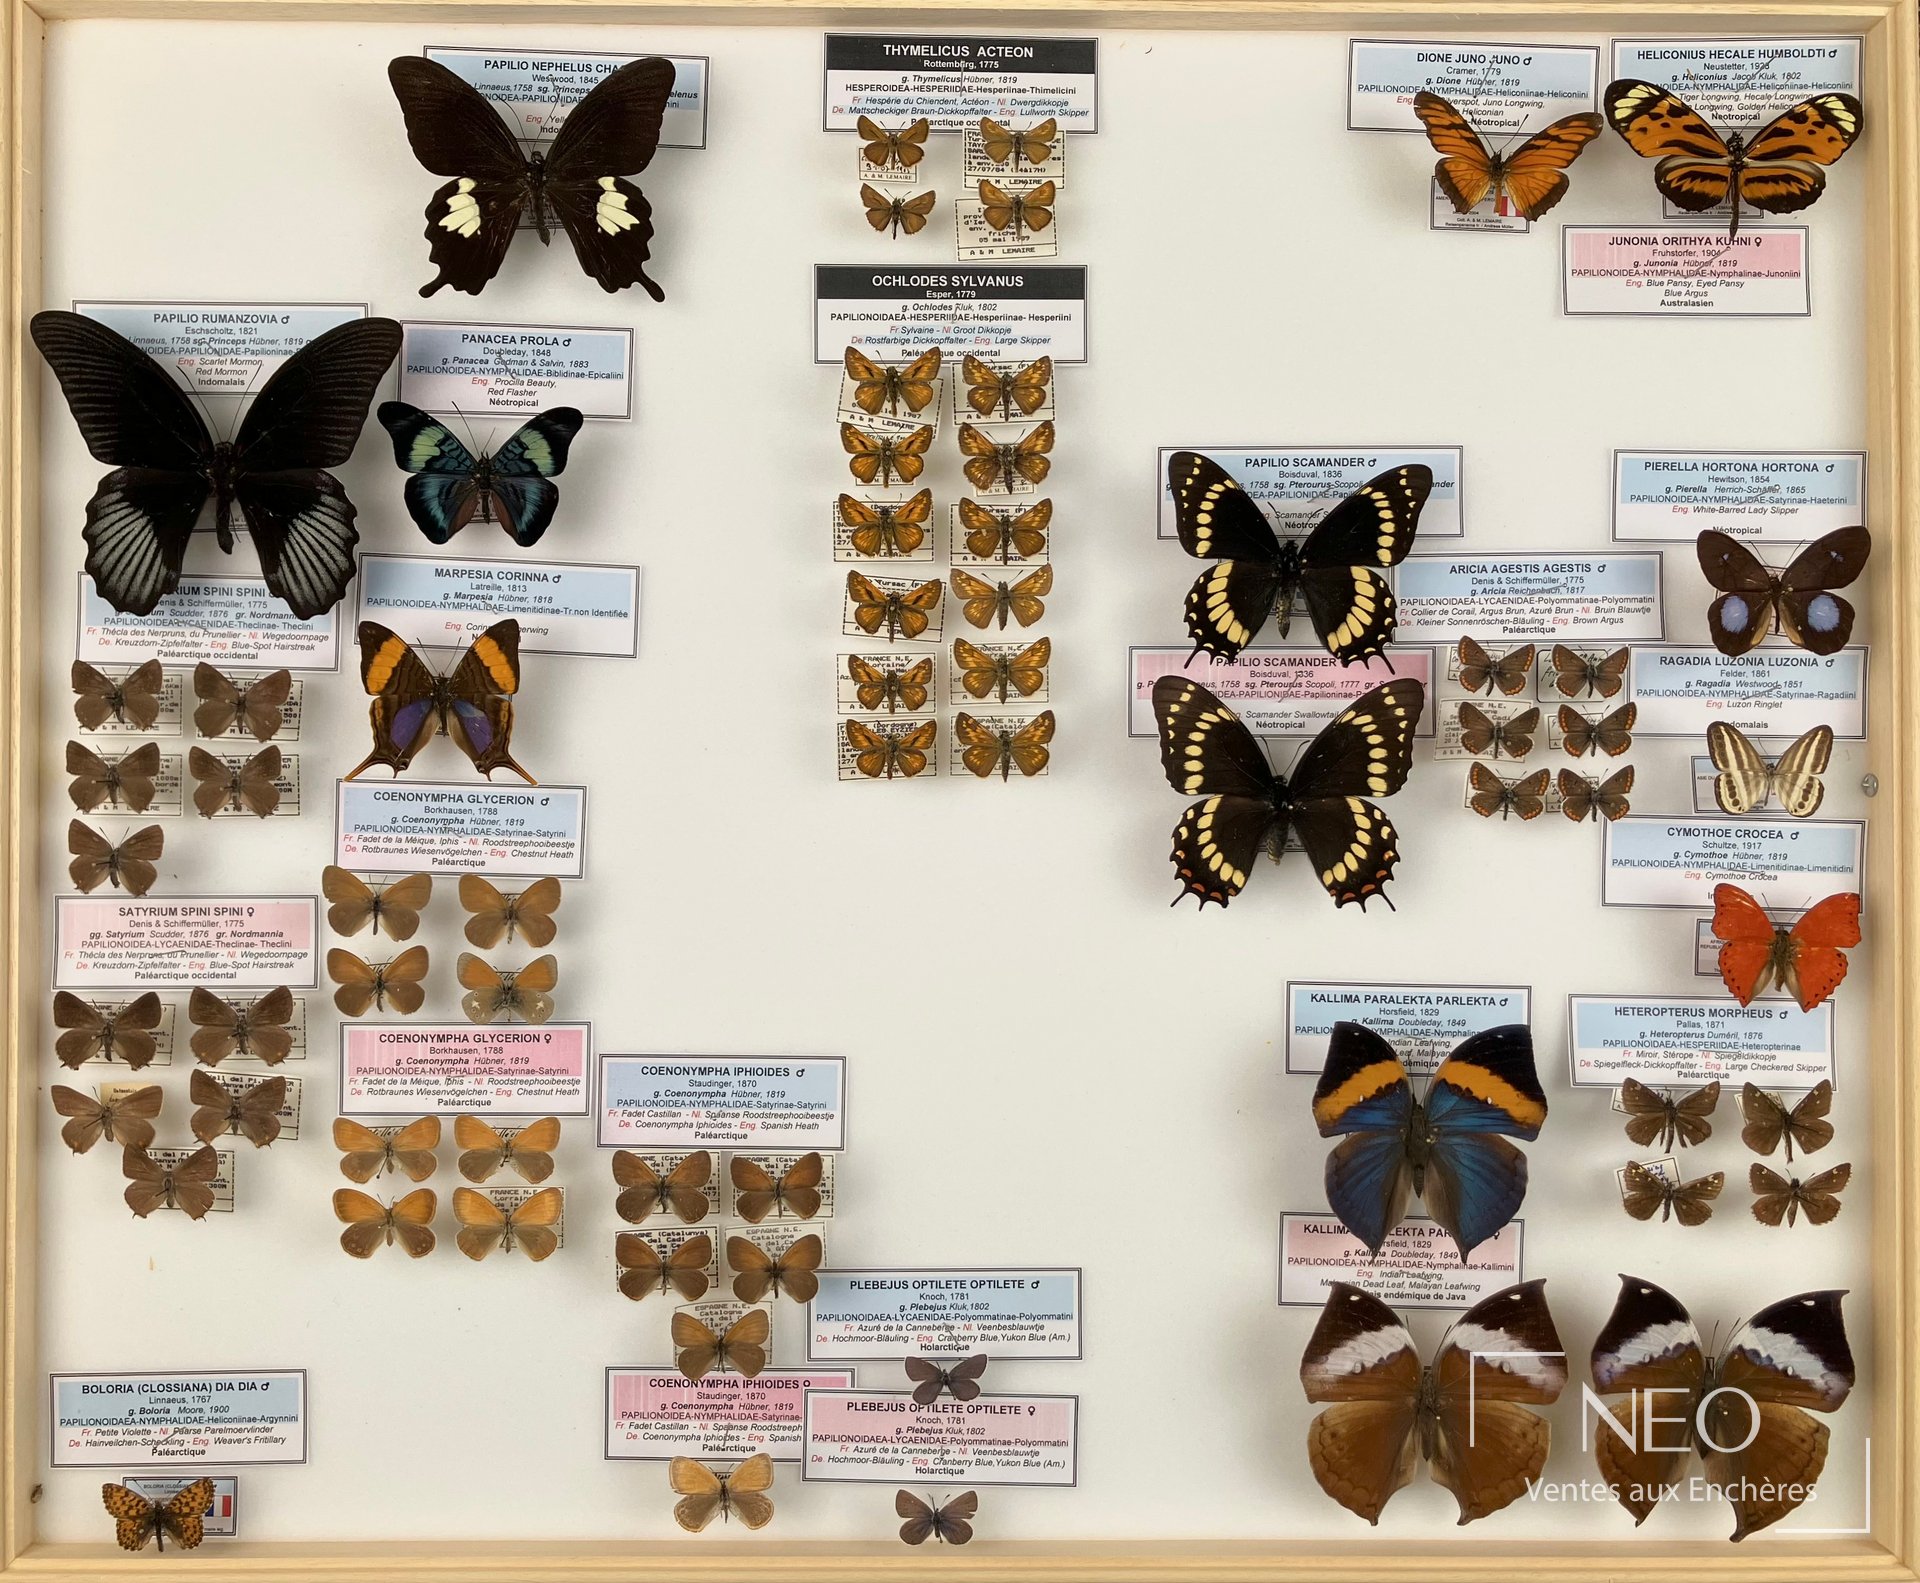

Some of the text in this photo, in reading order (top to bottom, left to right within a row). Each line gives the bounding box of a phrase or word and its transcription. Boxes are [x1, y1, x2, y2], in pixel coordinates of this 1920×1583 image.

[883, 44, 1034, 58] THYMELICUS ACTEON
[1637, 48, 1825, 60] HELICONIUS HECALE HUMBOLDTI
[1417, 52, 1486, 64] DIONE JUNO
[484, 60, 592, 73] PAPILIO NEPHELUS
[979, 60, 999, 69] 1775
[1446, 66, 1479, 75] Cramer,
[579, 75, 599, 84] 1845
[1608, 237, 1659, 246] JUNONIA
[1662, 236, 1712, 246] ORITHYA
[1652, 249, 1699, 257] Fruhstorfer,
[872, 275, 1024, 287] OCHLODES SYLVANUS
[926, 291, 954, 299] Esper,
[1664, 289, 1708, 298] Blue Argus
[1659, 299, 1714, 307] Australasien
[153, 314, 278, 324] PAPILIO RUMANZOVIA
[185, 327, 258, 336] Eschscholtz, 1821
[461, 334, 559, 346] PANACEA PROLA
[483, 347, 551, 357] Doubleday, 1848
[195, 368, 248, 376] Red Mormon
[198, 378, 245, 386] Indomalais
[487, 388, 537, 397] Red Flasher
[489, 398, 539, 408] Néotropical
[1245, 457, 1365, 468] PAPILIO SCAMANDER
[1644, 462, 1819, 472] PIERELLA HORTONA HORTONA
[1278, 470, 1342, 479] Boisduval, 1836
[1708, 475, 1748, 484] Hewitson,
[1692, 505, 1799, 515] White-Barred Lady Slipper
[1449, 564, 1591, 574] ARICIA AGESTIS AGESTIS
[434, 568, 549, 582] MARPESIA CORINNA
[1471, 577, 1495, 585] Denis
[1496, 577, 1503, 585] &
[1565, 576, 1584, 584] 1775
[203, 587, 266, 598] SPINI SPINI
[470, 583, 527, 592] Latreille, 1813
[248, 601, 268, 609] 1775
[1502, 625, 1556, 635] Paléarctique
[157, 650, 259, 660] Paléarctique occidental
[1216, 657, 1337, 667] PAPILIO SCAMANDER
[1659, 657, 1819, 667] RAGADIA LUZONIA LUZONIA
[1250, 670, 1292, 678] Boisduval,
[1720, 669, 1749, 678] Felder,
[1726, 700, 1783, 710] Luzon Ringlet
[1255, 721, 1305, 730] Néotropical
[373, 792, 534, 806] COENONYMPHA GLYCERION
[424, 806, 498, 816] Borkhausen, 1788
[1667, 827, 1784, 839] CYMOTHOE CROCEA
[1702, 841, 1762, 850] Schultze, 1917
[432, 858, 486, 867] Paléarctique
[118, 907, 244, 917] SATYRIUM SPINI SPINI
[129, 919, 244, 929] Denis & Schiffermüller, 1775
[134, 971, 237, 980] Paléarctique occidental
[1310, 994, 1496, 1006] KALLIMA PARALEKTA PARLEKTA
[1379, 1008, 1440, 1017] Horsfield, 1829
[1614, 1007, 1773, 1019] HETEROPTERUS MORPHEUS
[1676, 1020, 1725, 1029] Pallas, 1871
[379, 1034, 541, 1044] COENONYMPHA GLYCERION
[429, 1046, 504, 1055] Borkhausen, 1788
[641, 1066, 790, 1077] COENONYMPHA IPHIOIDES
[1677, 1070, 1730, 1080] Paléarctique
[688, 1079, 757, 1089] Staudinger, 1870
[437, 1098, 492, 1107] Paléarctique
[694, 1131, 748, 1141] Paléarctique
[1411, 1240, 1432, 1248] 1829
[850, 1280, 1025, 1290] PLEBEJUS OPTILETE OPTILETE
[919, 1292, 948, 1302] Knoch,
[1384, 1292, 1466, 1301] endémique de Java
[82, 1382, 257, 1395] BOLORIA (CLOSSIANA) DIA DIA
[649, 1378, 799, 1389] COENONYMPHA IPHIOIDES
[149, 1396, 211, 1405] Linnaeus, 1767
[697, 1392, 766, 1401] Staudinger, 1870
[847, 1402, 1022, 1415] PLEBEJUS OPTILETE OPTILETE
[915, 1416, 966, 1426] Knoch, 1781
[151, 1447, 206, 1457] Paléarctique
[915, 1466, 965, 1476] Holarctique
